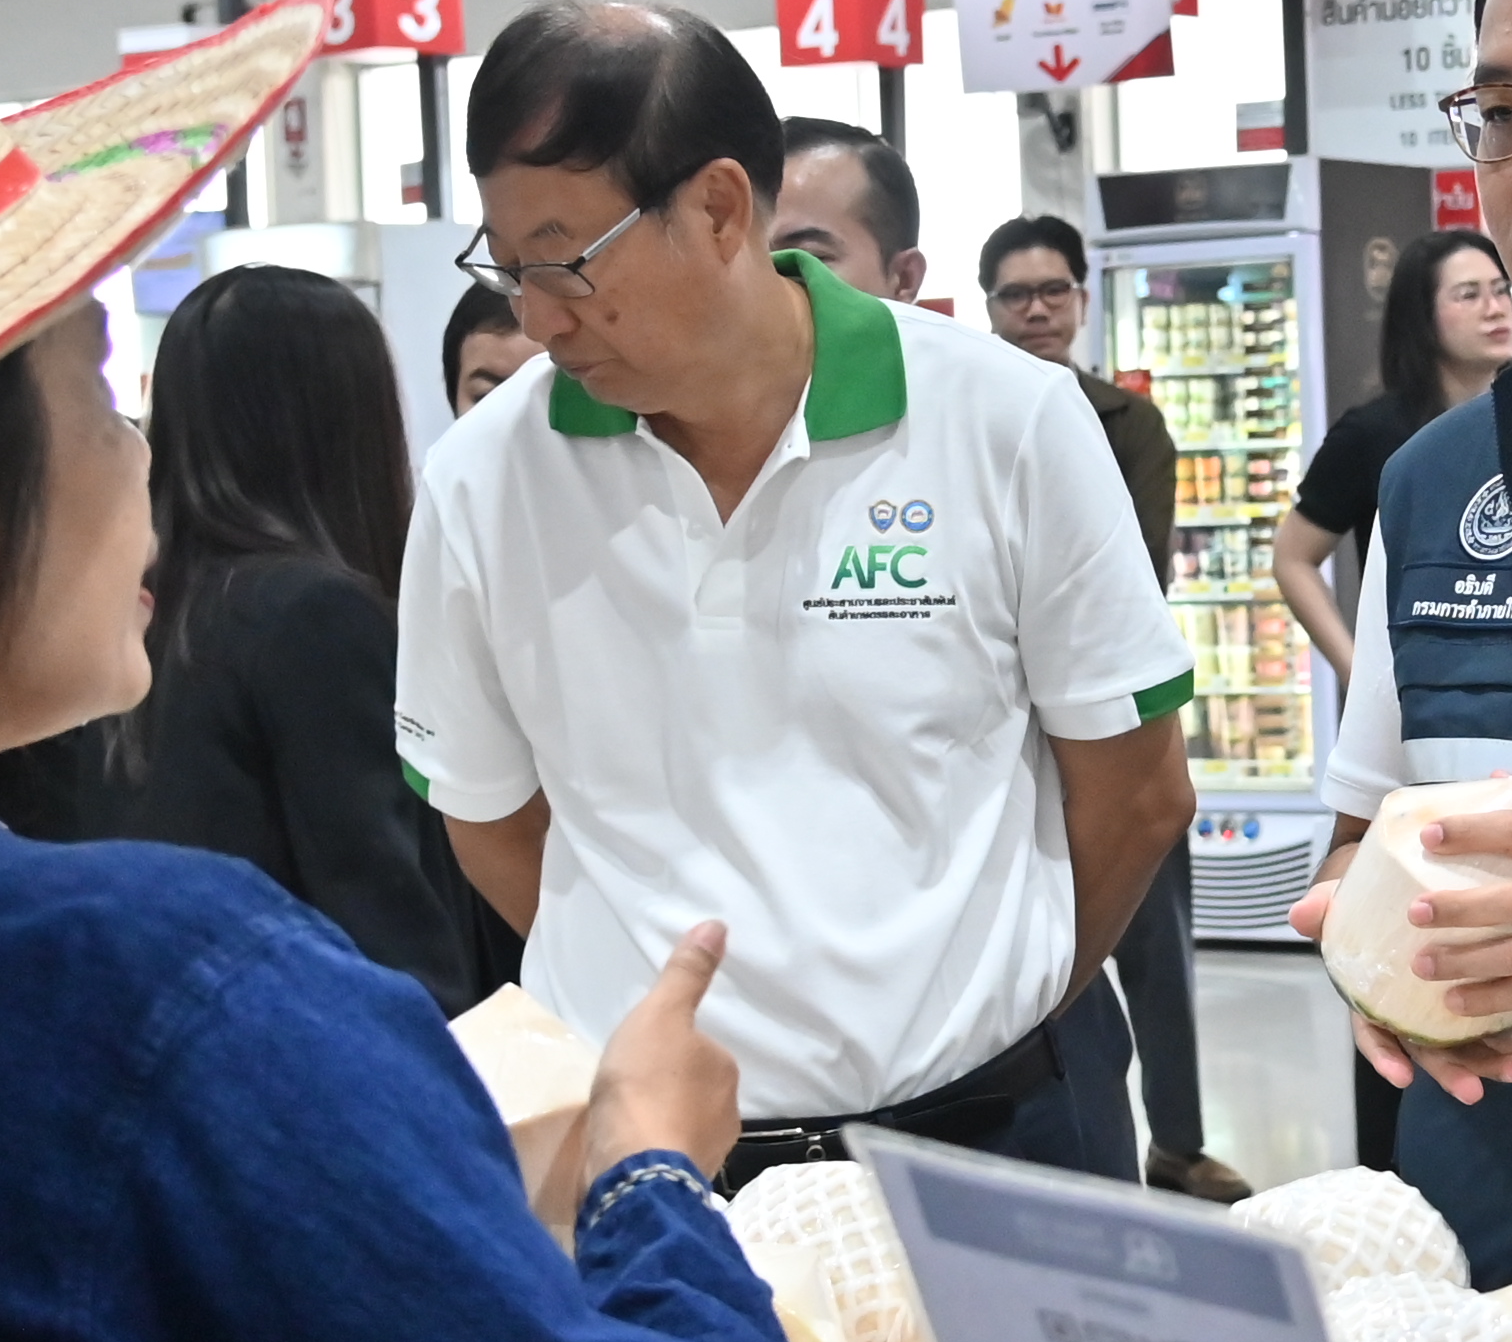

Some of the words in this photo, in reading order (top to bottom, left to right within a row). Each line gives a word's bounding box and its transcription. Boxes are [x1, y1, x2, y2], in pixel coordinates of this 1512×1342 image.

[1402, 46, 1430, 73] 10
[1388, 92, 1428, 112] LESS
[831, 545, 928, 589] AFC
[1454, 573, 1497, 596] อธิบดี
